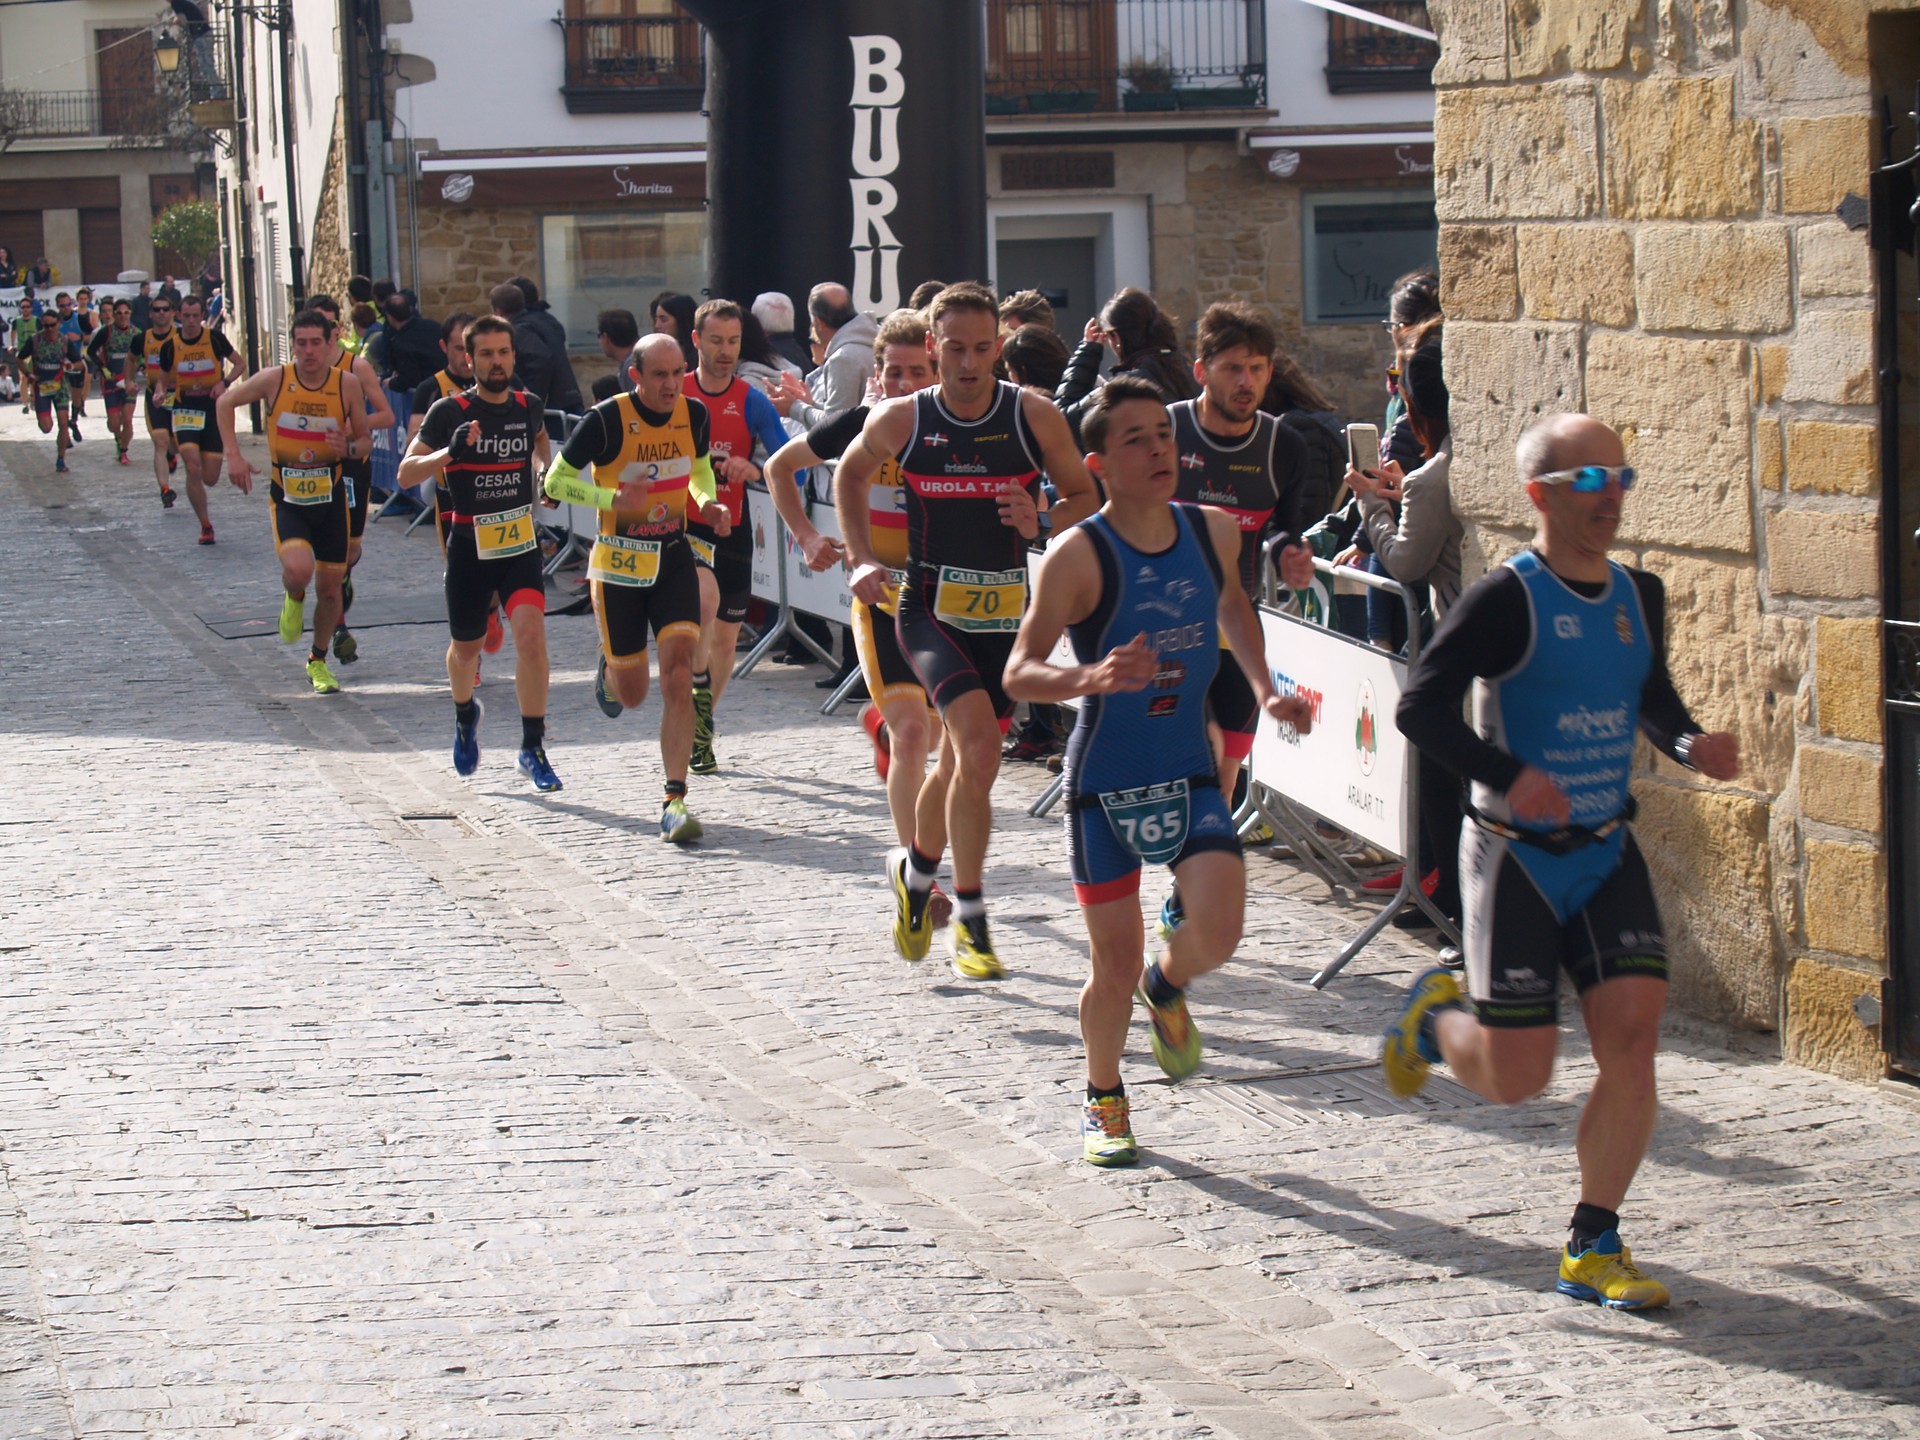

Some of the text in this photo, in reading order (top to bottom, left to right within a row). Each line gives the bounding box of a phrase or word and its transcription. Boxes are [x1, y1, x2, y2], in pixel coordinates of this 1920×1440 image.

[849, 35, 905, 319] BURU
[476, 433, 528, 458] trigoi
[636, 441, 682, 462] MAIZA
[296, 480, 317, 494] 40
[474, 472, 521, 488] CESAR
[920, 480, 977, 493] UROLA
[475, 488, 518, 499] BEASAIN
[494, 523, 520, 544] 74
[622, 540, 656, 552] RURAL
[610, 550, 638, 573] 54
[948, 570, 1020, 585] CAJA RURAL
[964, 590, 1000, 614] 70
[1118, 810, 1182, 843] 765
